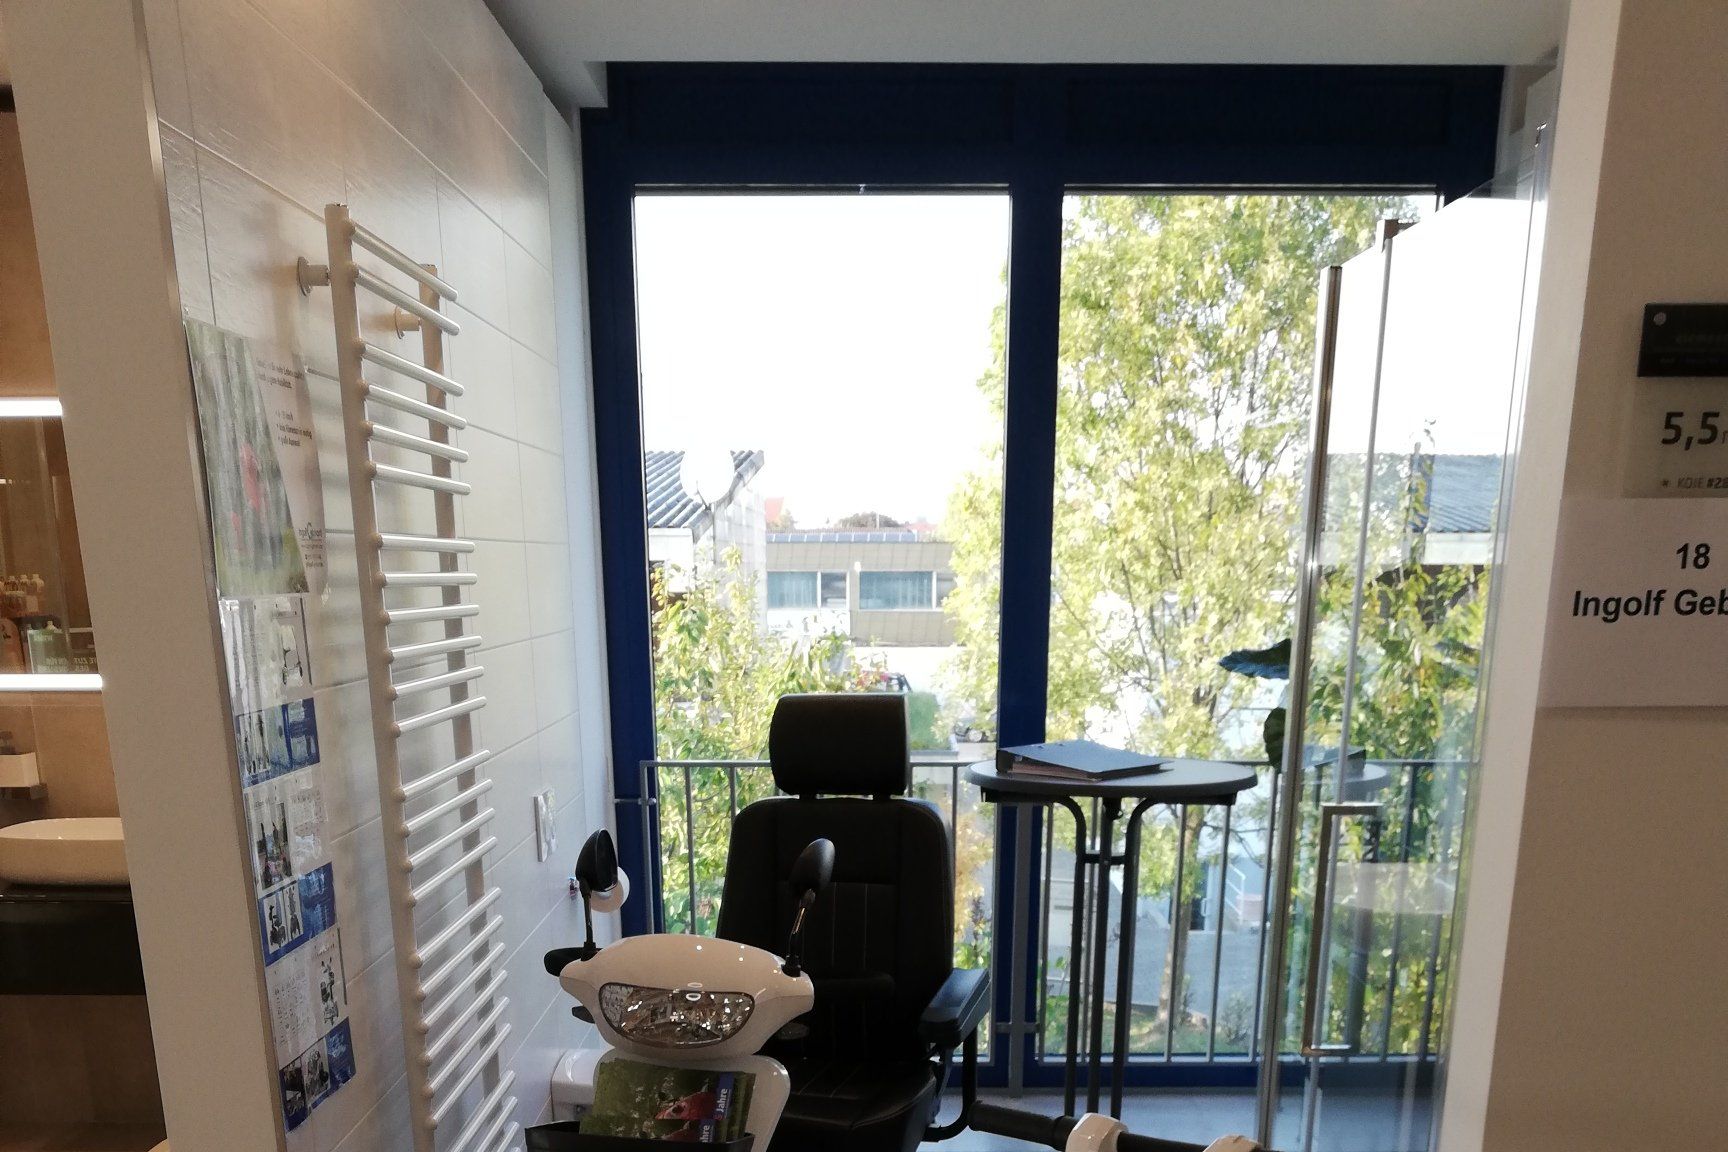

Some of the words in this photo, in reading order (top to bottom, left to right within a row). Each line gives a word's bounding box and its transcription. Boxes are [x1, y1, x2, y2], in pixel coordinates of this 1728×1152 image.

[1661, 411, 1720, 451] 5,5
[1676, 542, 1711, 570] 18
[1572, 589, 1668, 623] Ingolf
[716, 1088, 728, 1112] Jahre
